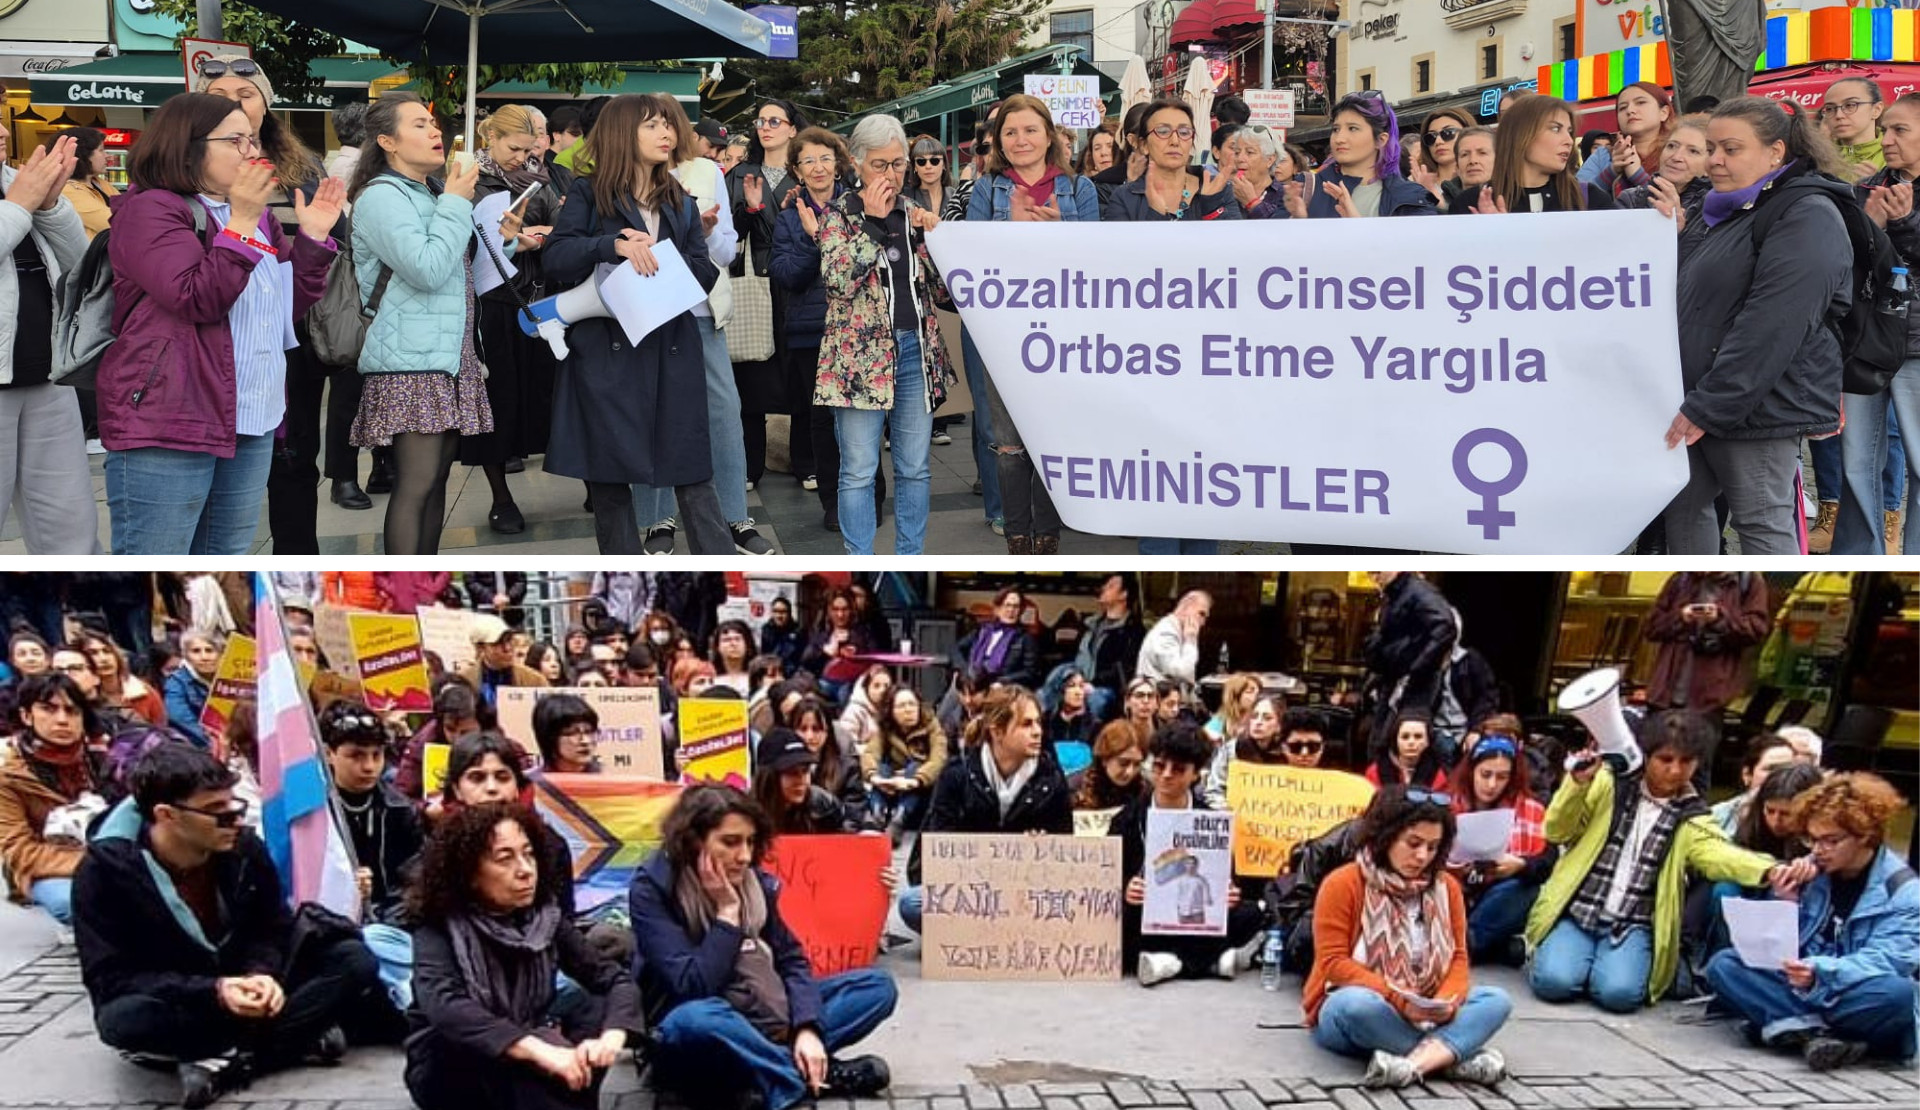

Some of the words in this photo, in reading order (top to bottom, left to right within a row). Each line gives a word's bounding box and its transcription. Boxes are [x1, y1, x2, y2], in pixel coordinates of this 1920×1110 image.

[946, 267, 1237, 310] Gözaltındaki
[1257, 266, 1425, 311] Cinsel
[1446, 263, 1651, 324] Şiddeti
[1021, 321, 1182, 376] Örtbas
[1201, 334, 1334, 380] Etme
[1351, 336, 1547, 394] Yargıla
[1041, 449, 1391, 515] FEMİNİSTLER
